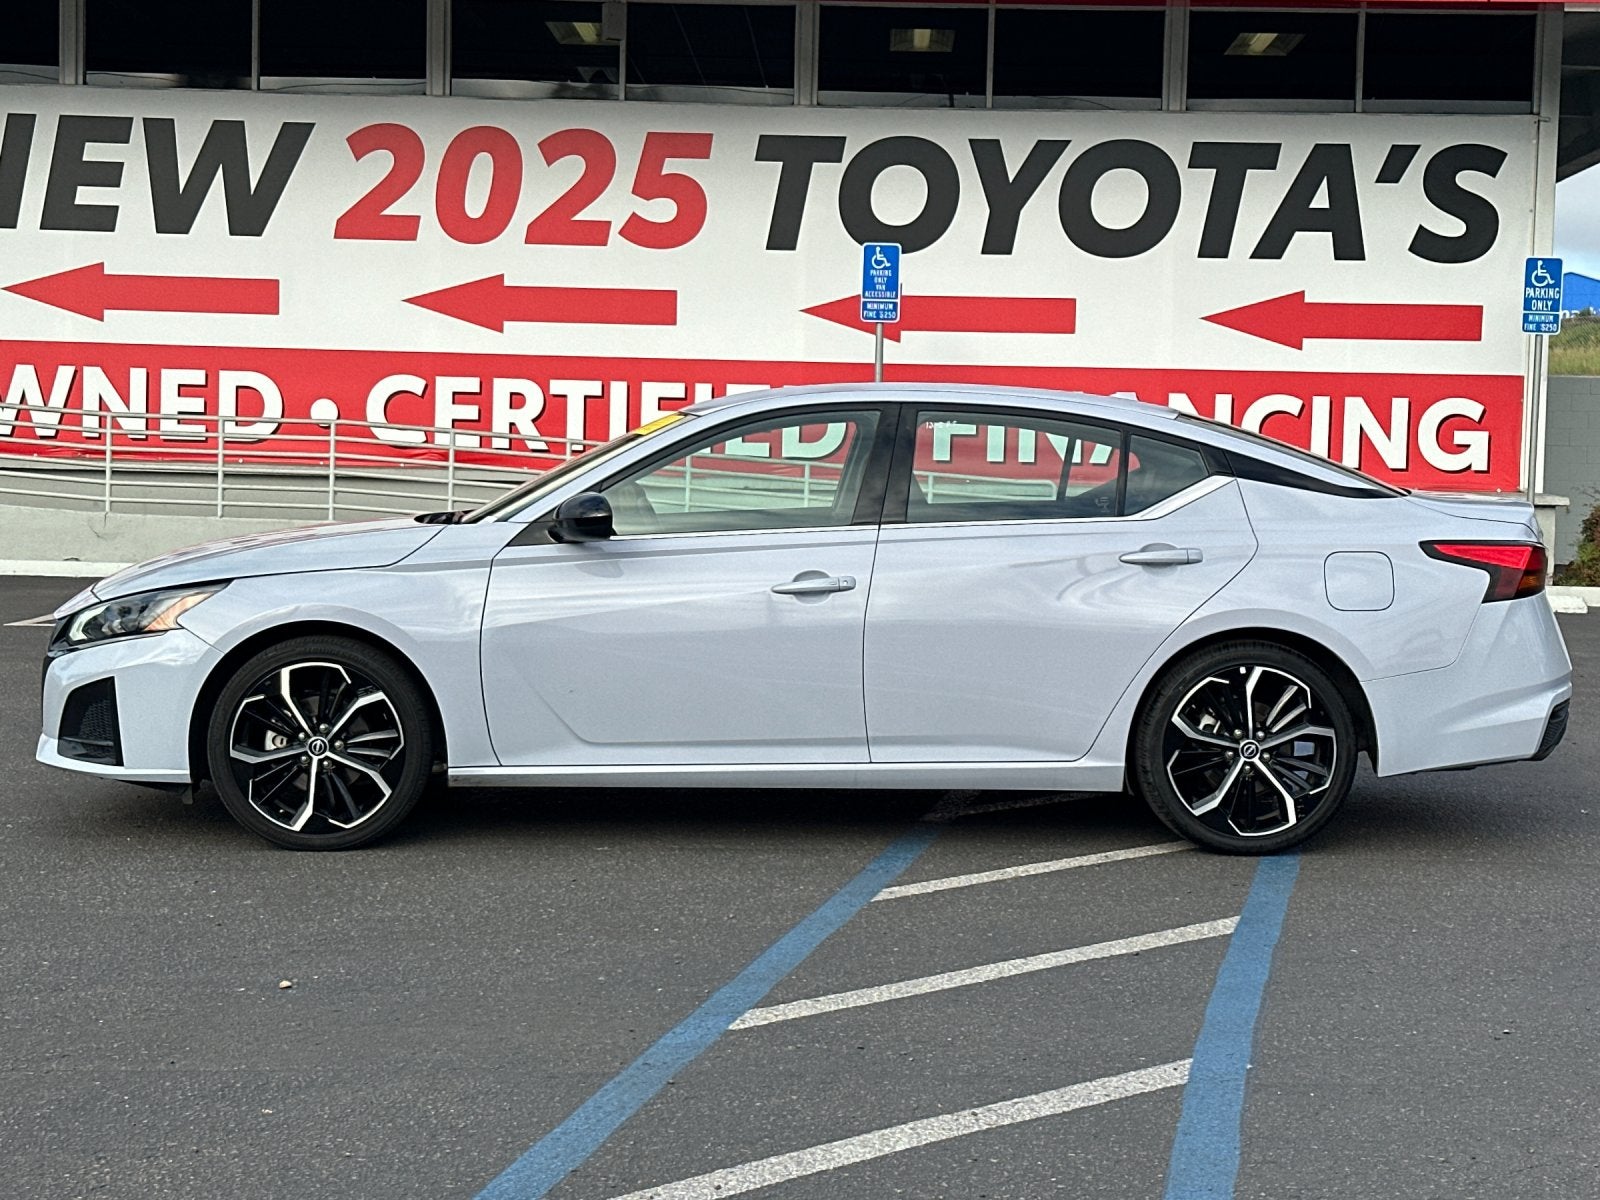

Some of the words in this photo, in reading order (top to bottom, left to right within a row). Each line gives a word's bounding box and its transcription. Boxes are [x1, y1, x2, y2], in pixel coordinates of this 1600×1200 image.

[333, 122, 714, 250] 2025
[754, 134, 1508, 264] TOYOTA'S
[1525, 287, 1560, 299] PARKING
[1531, 300, 1553, 311] ONLY
[1528, 314, 1554, 323] MINIMUM
[1524, 323, 1537, 331] FINE
[1540, 323, 1558, 332] $250
